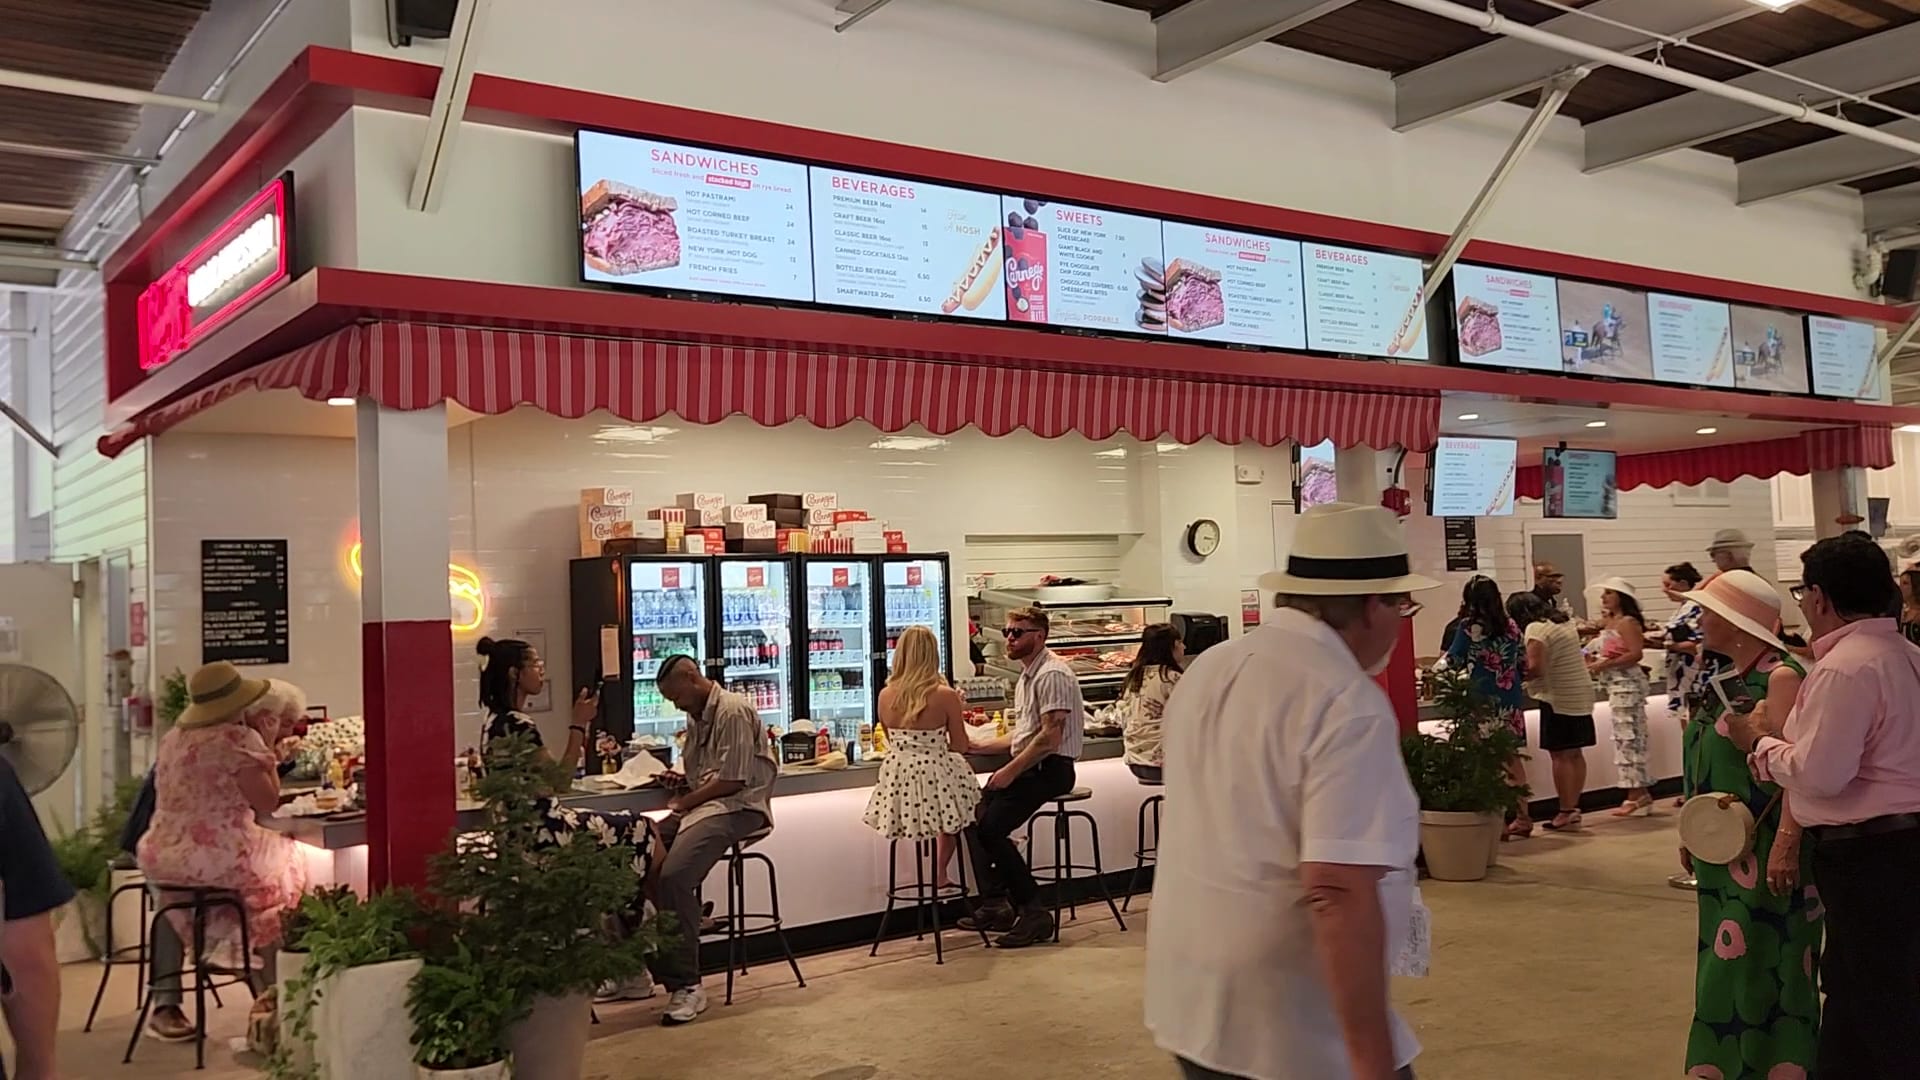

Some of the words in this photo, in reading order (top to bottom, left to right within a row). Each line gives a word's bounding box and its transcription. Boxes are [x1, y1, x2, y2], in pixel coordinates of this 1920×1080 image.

[651, 149, 759, 176] SANDWICHES
[652, 168, 672, 176] Sliced
[674, 170, 691, 179] fresh
[692, 173, 705, 181] and
[708, 175, 734, 186] stacked
[735, 178, 749, 188] high
[832, 176, 915, 200] BEVERAGES
[702, 193, 736, 202] PASTRAMI
[833, 195, 861, 205] PREMIUM
[703, 209, 731, 219] CORNED
[833, 212, 854, 220] CRAFT
[1056, 210, 1103, 226] SWEETS
[687, 226, 720, 236] ROASTED
[721, 231, 748, 240] TURKEY
[750, 234, 775, 243] BREAST
[834, 229, 860, 239] CLASSIC
[956, 225, 980, 235] NOSH
[1058, 234, 1090, 243] CHEESECAKE
[1205, 233, 1271, 252] SANDWICHES
[835, 247, 861, 256] CANNED
[863, 250, 895, 260] COCKTAILS
[1315, 249, 1369, 266] BEVERAGES
[689, 264, 717, 272] FRENCH
[719, 267, 738, 275] FRIES
[836, 264, 864, 273] BOTTLED
[865, 267, 897, 276] BEVERAGE
[1070, 263, 1100, 271] CHOCOLATE
[1060, 279, 1090, 287] CHOCOLATE
[1486, 274, 1533, 289] SANDWICHES
[837, 288, 879, 297] SMARTWATER
[1061, 286, 1093, 295] CHEESECAKE
